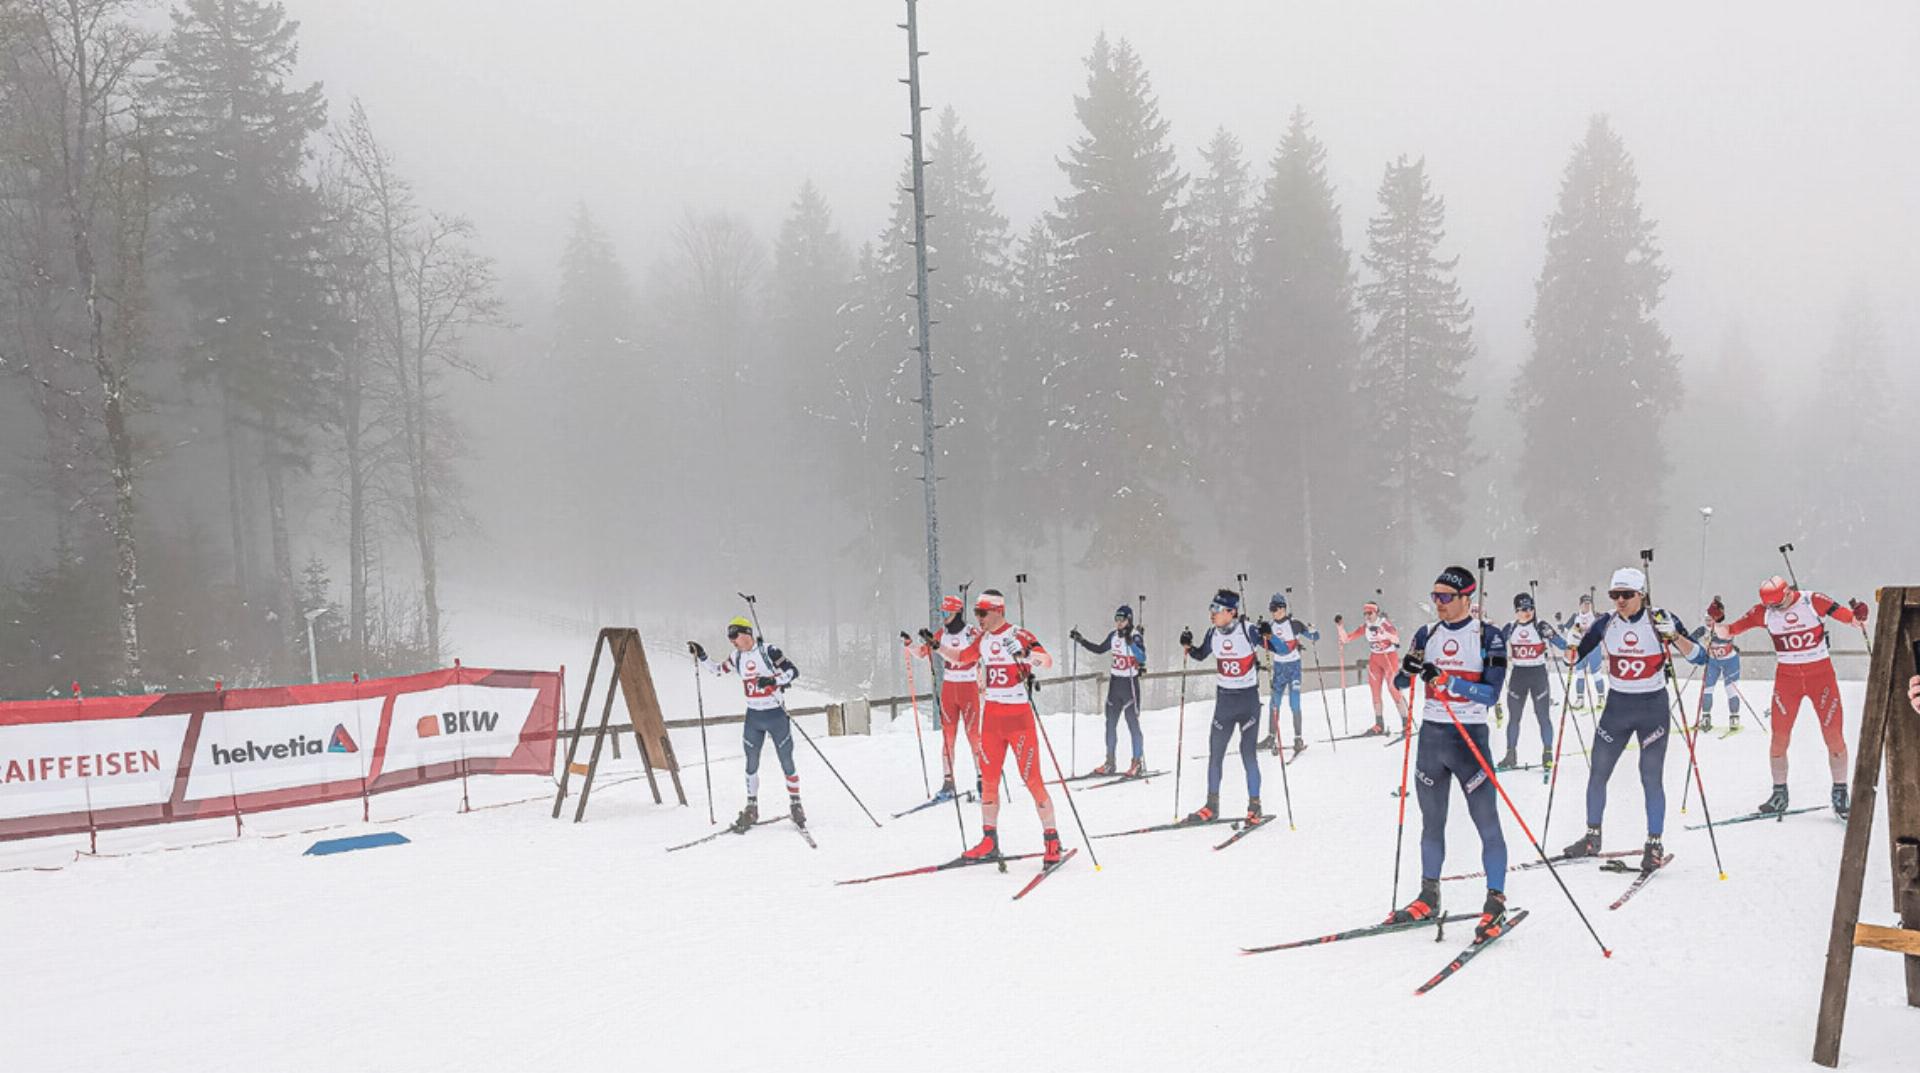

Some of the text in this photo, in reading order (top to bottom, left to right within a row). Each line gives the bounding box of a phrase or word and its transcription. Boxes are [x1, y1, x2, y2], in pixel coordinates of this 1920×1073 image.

[1780, 631, 1817, 649] 102
[1222, 661, 1241, 676] 98
[1434, 658, 1464, 666] Sunrise
[1617, 659, 1646, 678] 99
[989, 668, 1009, 685] 95
[442, 710, 499, 735] BKW
[211, 735, 323, 766] helvetia
[0, 749, 161, 784] AIFFEISEN
